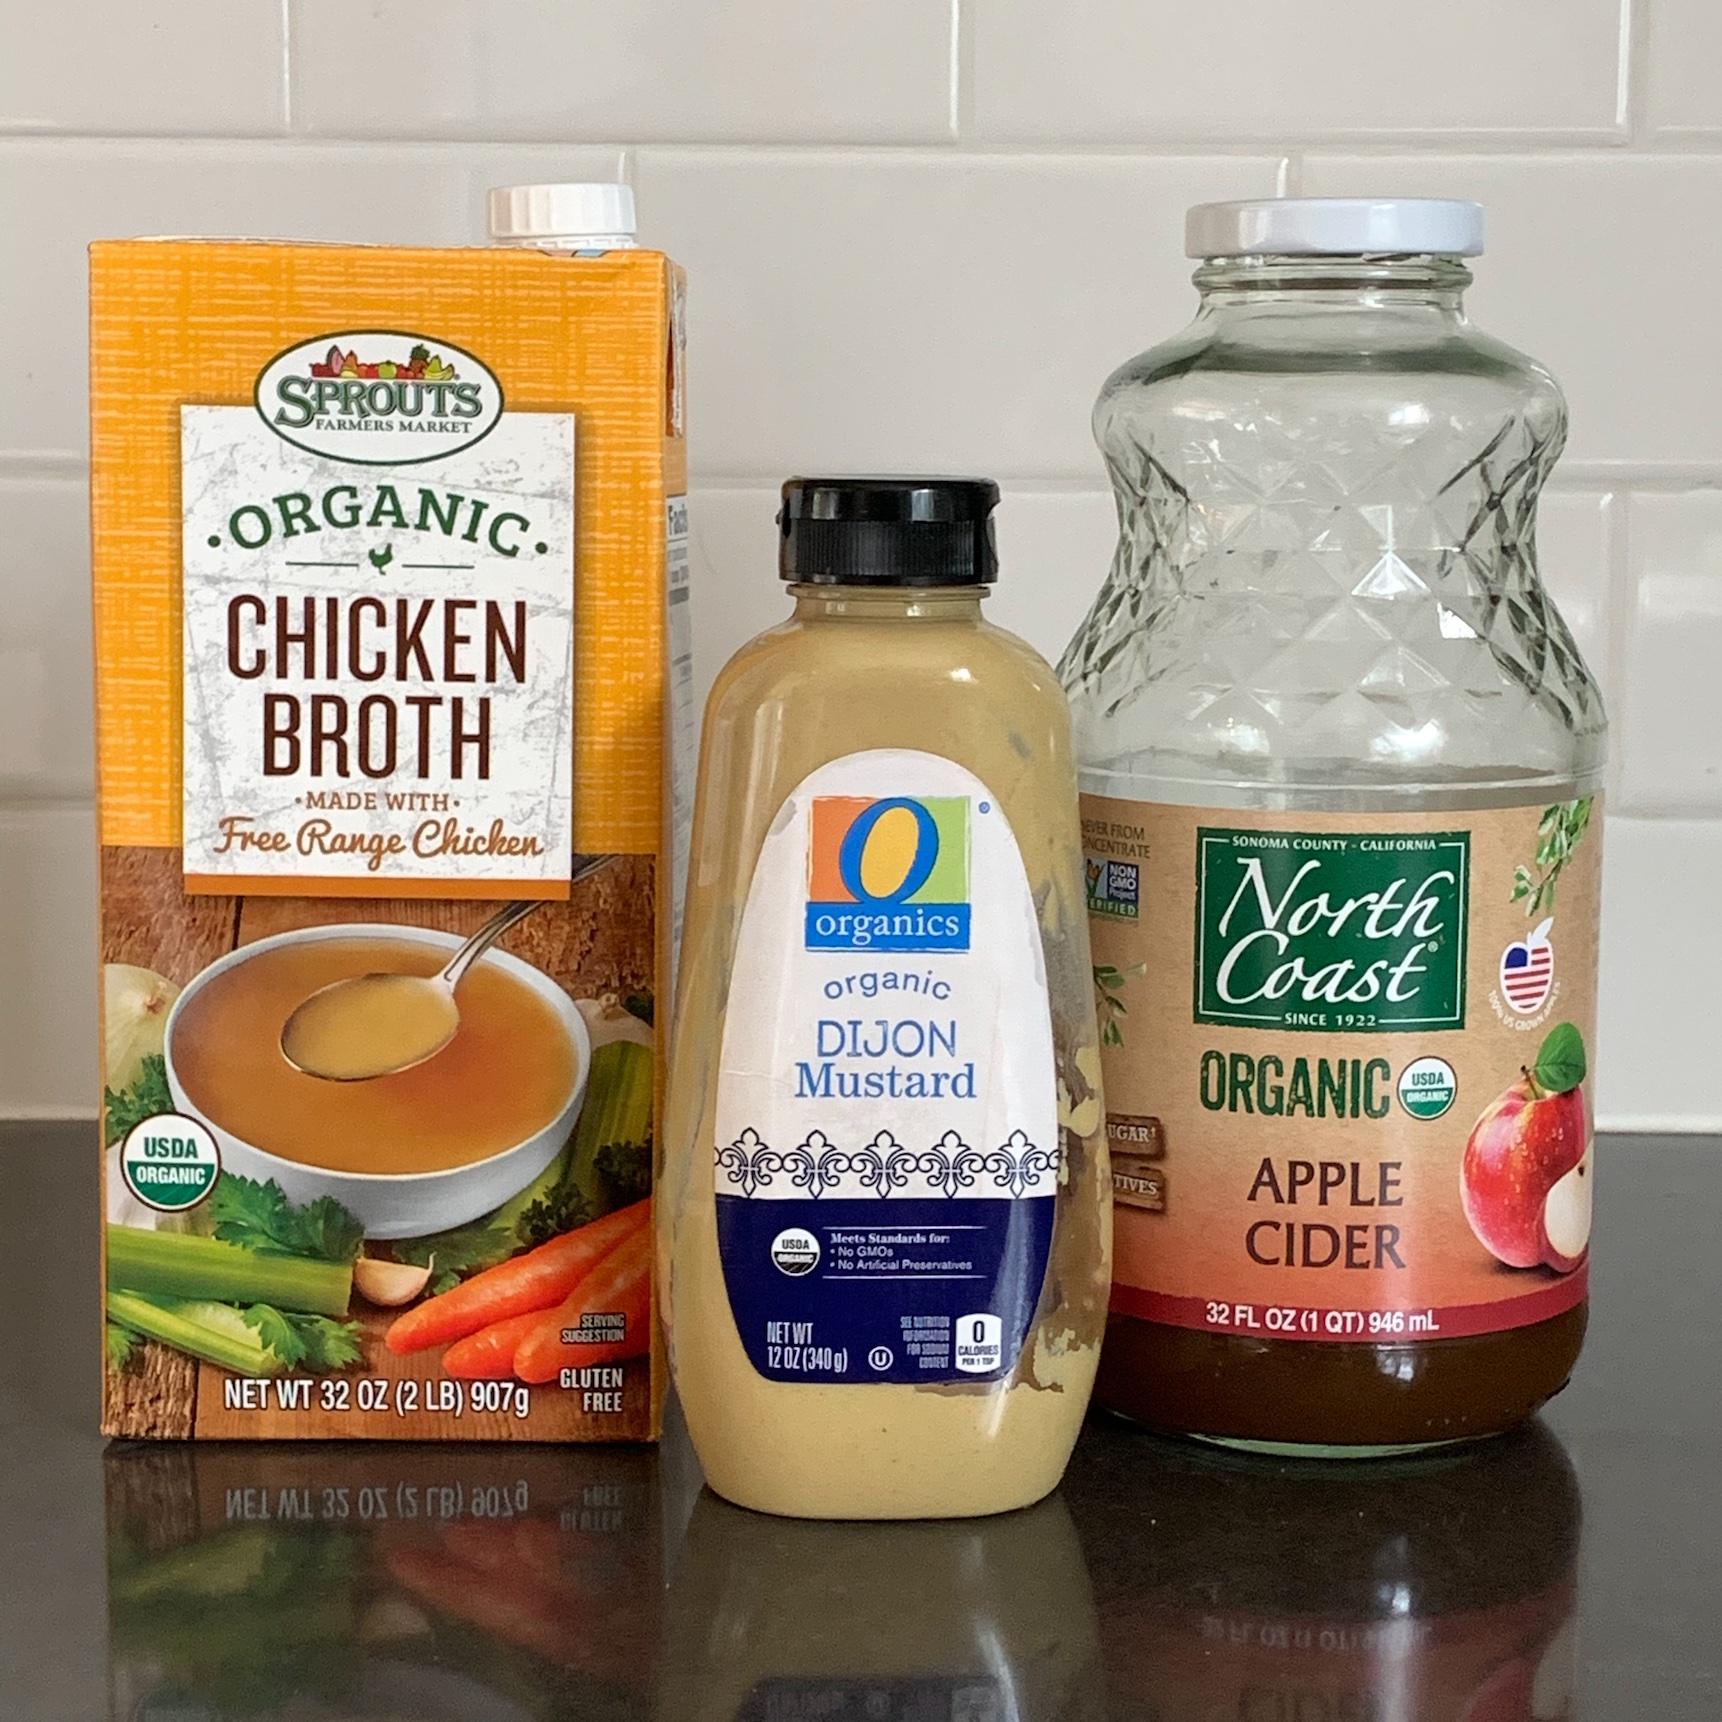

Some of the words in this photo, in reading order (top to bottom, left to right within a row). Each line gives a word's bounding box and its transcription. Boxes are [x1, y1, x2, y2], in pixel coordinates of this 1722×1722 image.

[274, 375, 483, 428] SPROUTS
[315, 418, 394, 432] FARMERS
[399, 420, 473, 433] MARKET
[228, 484, 531, 558] ORGANIC
[226, 594, 527, 684] CHICKEN
[262, 692, 491, 781] BROTH
[306, 791, 377, 811] MADE
[384, 792, 449, 811] WITH
[1111, 824, 1145, 841] FROM
[1231, 835, 1289, 850] SONOMA
[1292, 838, 1348, 851] COUNTY
[1360, 839, 1437, 851] CALIFORNIA
[213, 816, 291, 854] Free
[296, 818, 407, 872] Range
[412, 817, 545, 859] Chicken
[1109, 864, 1137, 879] NON
[1109, 876, 1137, 890] GMO
[1088, 898, 1136, 916] ERIFIED
[1218, 857, 1455, 939] North
[815, 910, 960, 946] organics
[1216, 929, 1427, 1005] Coast
[822, 969, 952, 1001] organic
[1284, 1013, 1327, 1026] SINCE
[1335, 1014, 1376, 1027] 1922
[816, 1019, 957, 1058] DIJON
[794, 1062, 977, 1099] Mustard
[1200, 1050, 1391, 1119] ORGANIC
[1411, 1072, 1445, 1087] USDA
[1406, 1090, 1450, 1103] ORGANIC
[143, 1136, 199, 1159] USDA
[135, 1165, 206, 1185] ORGANIC
[1112, 1173, 1158, 1196] TIVES
[1247, 1157, 1403, 1207] APPLE
[781, 1239, 810, 1250] USDA
[830, 1233, 866, 1244] Meets
[867, 1233, 926, 1244] Standards
[928, 1233, 950, 1244] for:
[1245, 1220, 1406, 1270] CIDER
[837, 1246, 854, 1257] No
[856, 1246, 893, 1257] GMOs
[837, 1259, 854, 1270] No
[856, 1259, 900, 1271] Artificial
[902, 1259, 973, 1271] Preservatives
[581, 1314, 625, 1328] SERVING
[1206, 1301, 1230, 1324] 32
[1234, 1305, 1260, 1328] FL
[1265, 1308, 1296, 1331] OZ
[1300, 1310, 1318, 1333] (1
[1325, 1311, 1364, 1334] QT)
[1368, 1311, 1403, 1333] 946
[1408, 1309, 1440, 1332] mL
[561, 1328, 625, 1343] SUGGESTION
[766, 1321, 790, 1344] NET
[791, 1321, 813, 1345] WT
[972, 1320, 985, 1344] 0
[767, 1347, 781, 1369] 12
[783, 1347, 801, 1369] OZ
[958, 1344, 999, 1356] CALORIES
[560, 1367, 623, 1389] GLUTEN
[224, 1379, 271, 1409] NET
[276, 1379, 314, 1409] WT
[320, 1379, 350, 1410] 32
[357, 1379, 389, 1411] OZ
[396, 1379, 418, 1416] (2
[425, 1379, 463, 1417] LB)
[470, 1381, 530, 1418] 907g
[583, 1391, 622, 1412] FREE
